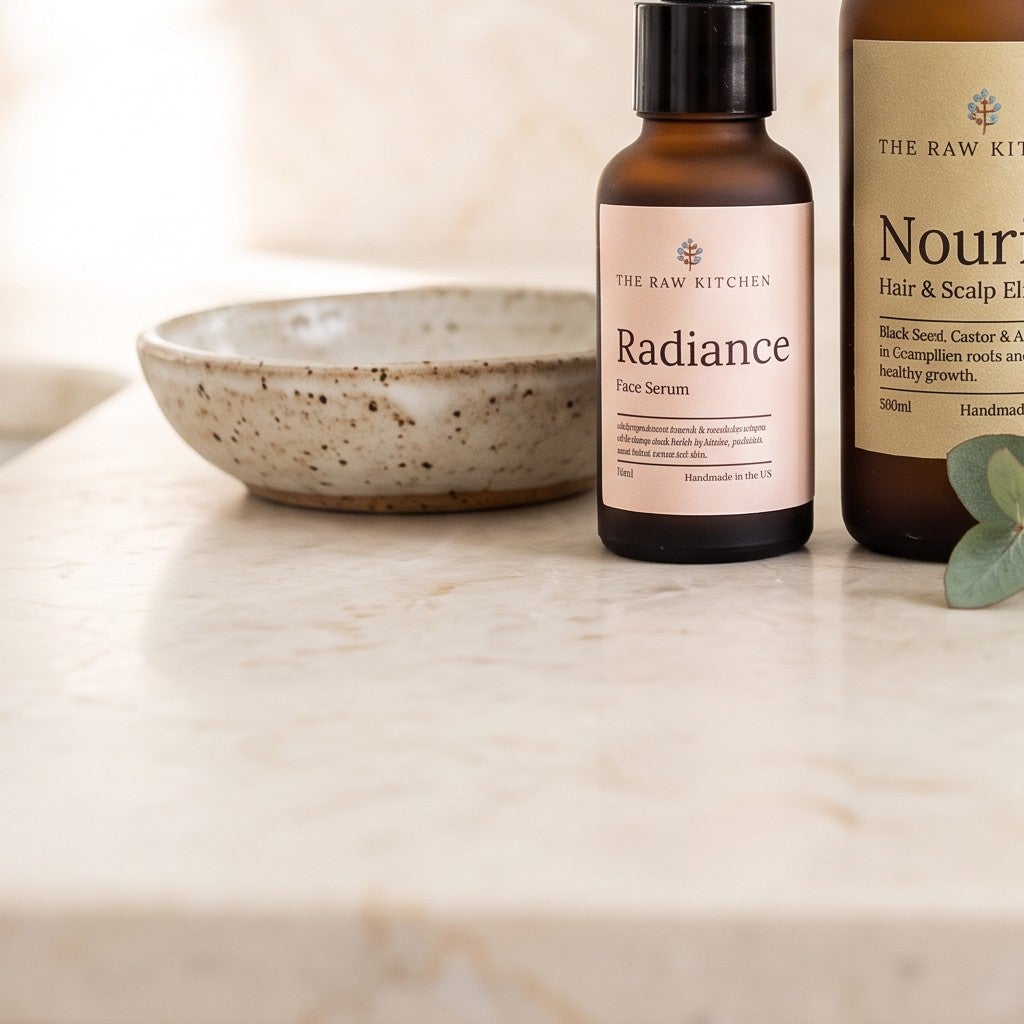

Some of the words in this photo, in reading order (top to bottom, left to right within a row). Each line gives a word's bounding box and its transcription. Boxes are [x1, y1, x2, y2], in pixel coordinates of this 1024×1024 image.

[879, 139, 917, 155] THE
[927, 141, 979, 157] RAW
[616, 274, 642, 287] THE
[650, 277, 686, 288] RAW
[695, 275, 771, 288] KITCHEN
[879, 277, 916, 297] Hair
[921, 280, 936, 298] &
[941, 280, 996, 304] Scalp
[879, 326, 909, 340] Black
[951, 330, 996, 343] Castor
[1000, 330, 1011, 342] &
[617, 328, 790, 367] Radiance
[879, 345, 889, 358] in
[966, 349, 1002, 363] roots
[879, 364, 922, 383] healthy
[925, 369, 977, 384] growth.
[616, 379, 642, 393] Face
[645, 382, 690, 395] Serum
[685, 474, 733, 482] Handmade
[735, 473, 743, 481] in
[745, 472, 758, 480] the
[760, 470, 772, 478] US
